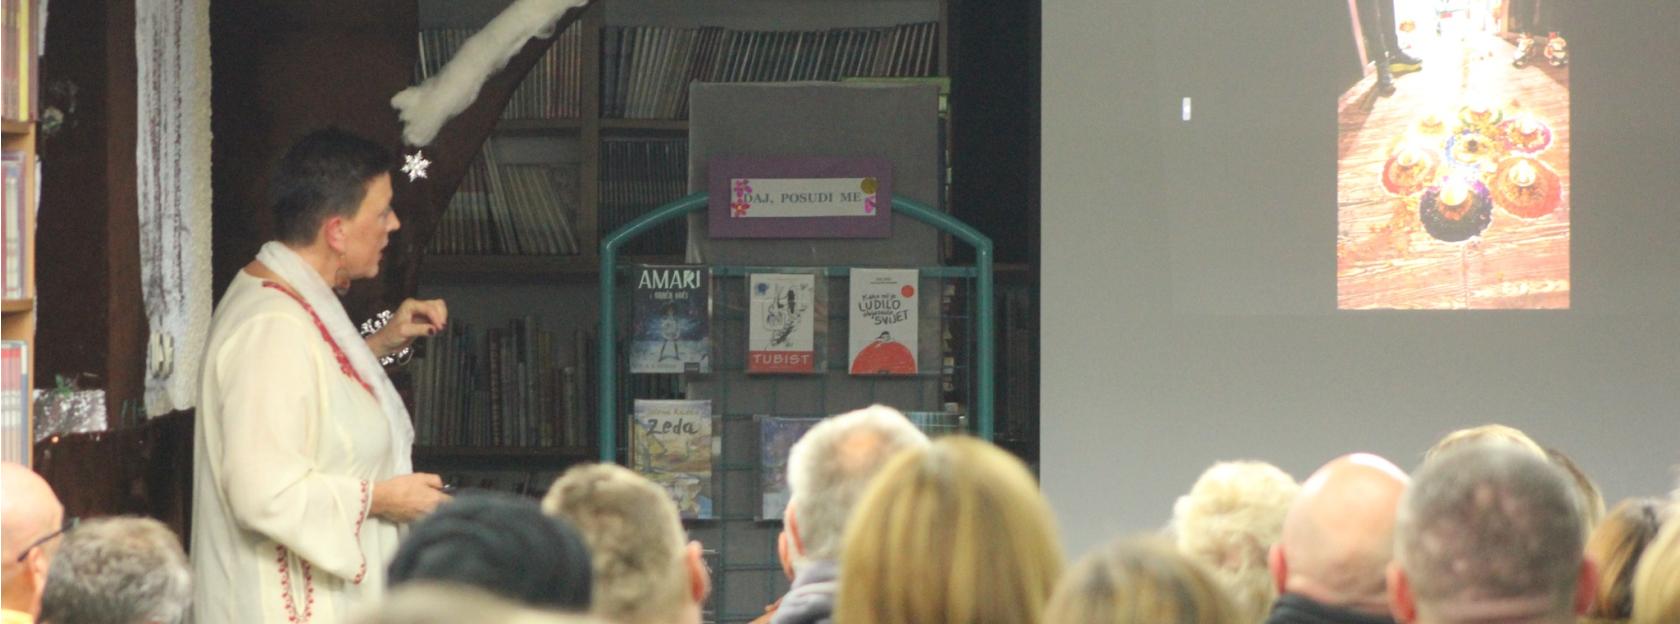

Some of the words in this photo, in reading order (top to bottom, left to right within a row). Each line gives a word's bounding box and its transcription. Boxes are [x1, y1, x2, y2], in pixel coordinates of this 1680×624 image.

[781, 192, 833, 203] POSUDI
[840, 191, 862, 202] ME
[638, 269, 701, 289] AMARI
[858, 299, 902, 312] LUDILO
[874, 309, 910, 326] SVIJET
[754, 354, 810, 365] TUBIST
